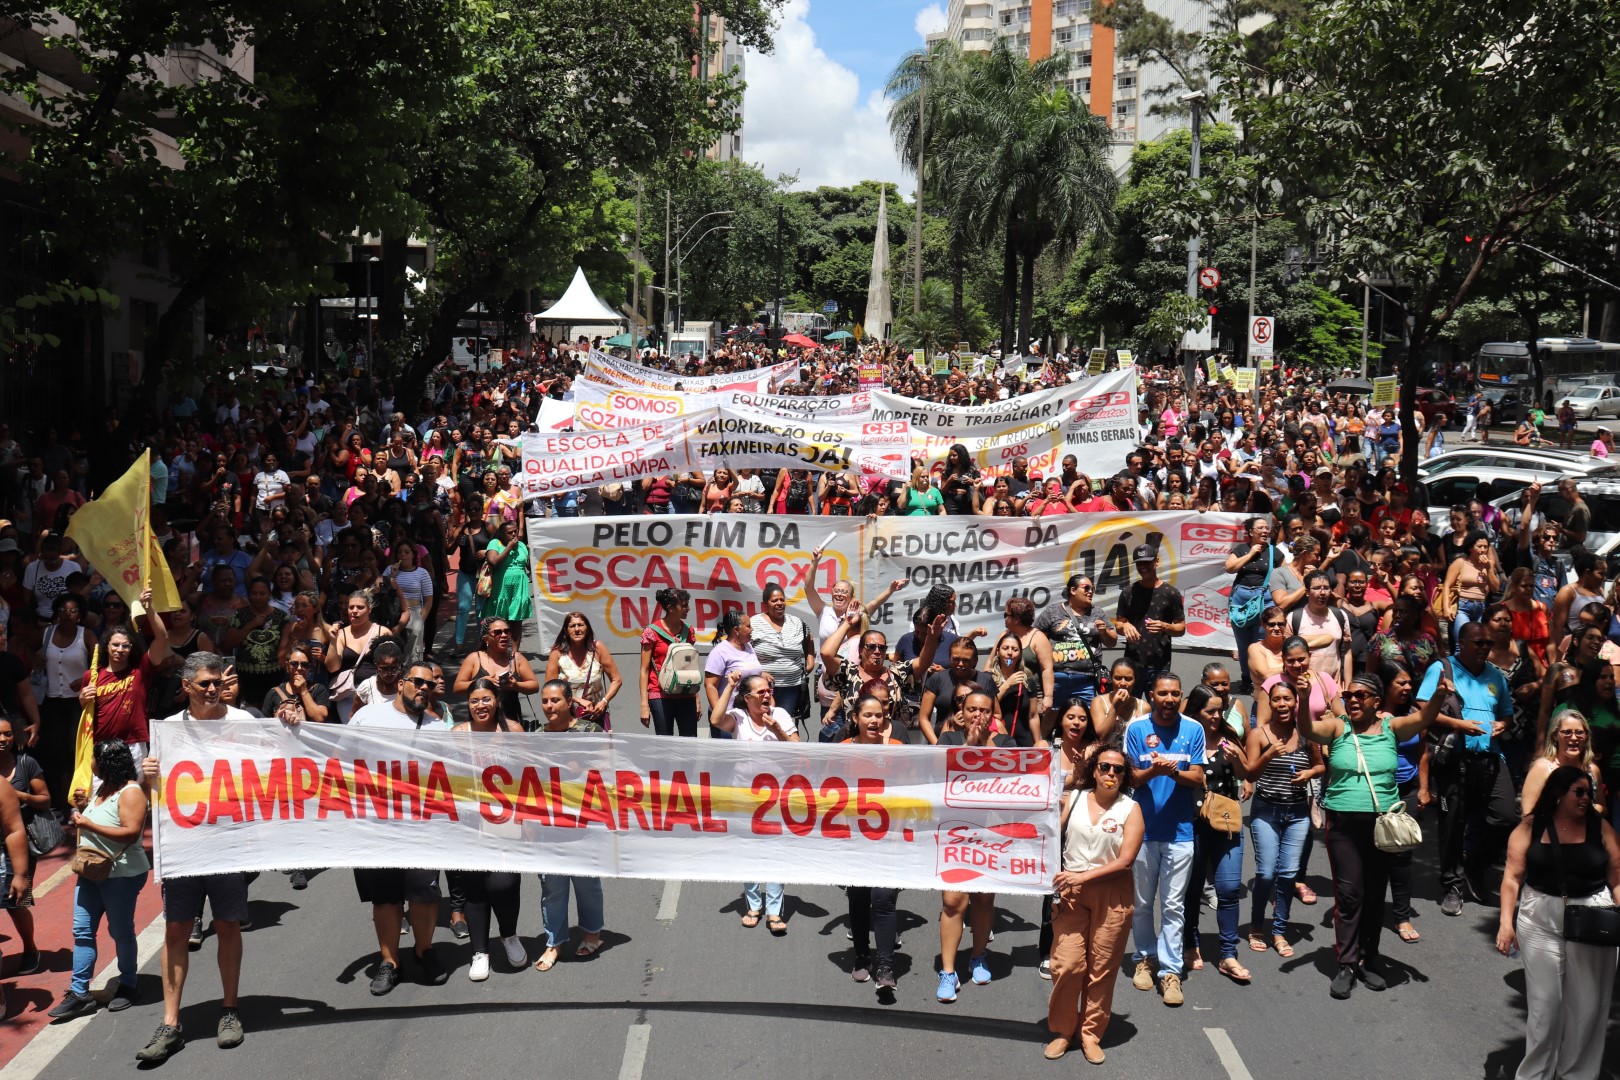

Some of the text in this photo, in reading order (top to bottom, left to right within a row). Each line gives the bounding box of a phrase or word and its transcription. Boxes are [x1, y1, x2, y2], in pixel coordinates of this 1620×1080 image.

[711, 371, 758, 385] ESCOLARES
[614, 395, 677, 415] SOMOS
[732, 393, 841, 412] EQUIPARAÇÃO
[937, 415, 955, 426] DE
[965, 399, 1063, 426] TRABALHAR!
[1074, 393, 1126, 410] CSP
[1073, 408, 1128, 422] Conlutas
[547, 425, 664, 453] ESCOLA DE
[698, 418, 845, 443] VALORIZAÇÃO das
[866, 422, 904, 434] CSP
[976, 438, 1000, 450] SEM
[1006, 420, 1060, 444] REDUÇÃO
[1066, 428, 1135, 445] MINAS GERAIS
[926, 436, 956, 447] FIM
[1001, 442, 1028, 459] DOS
[525, 447, 645, 475] QUALIDADE
[701, 440, 853, 470] FAXINEIRAS JÁ!
[980, 448, 1059, 481] SALÁOS!
[527, 471, 605, 493] ESCOLA
[593, 521, 800, 549] PELO FIM DA
[869, 523, 1060, 558] REDUÇÃO DA
[546, 555, 742, 593] ESCALA
[903, 557, 1020, 588] JORNADA
[955, 748, 1043, 771] CSP
[165, 758, 460, 829] CAMPANHA
[479, 765, 728, 833] SALARIAL
[949, 774, 1042, 798] Conlutas
[947, 826, 1014, 854] Sind
